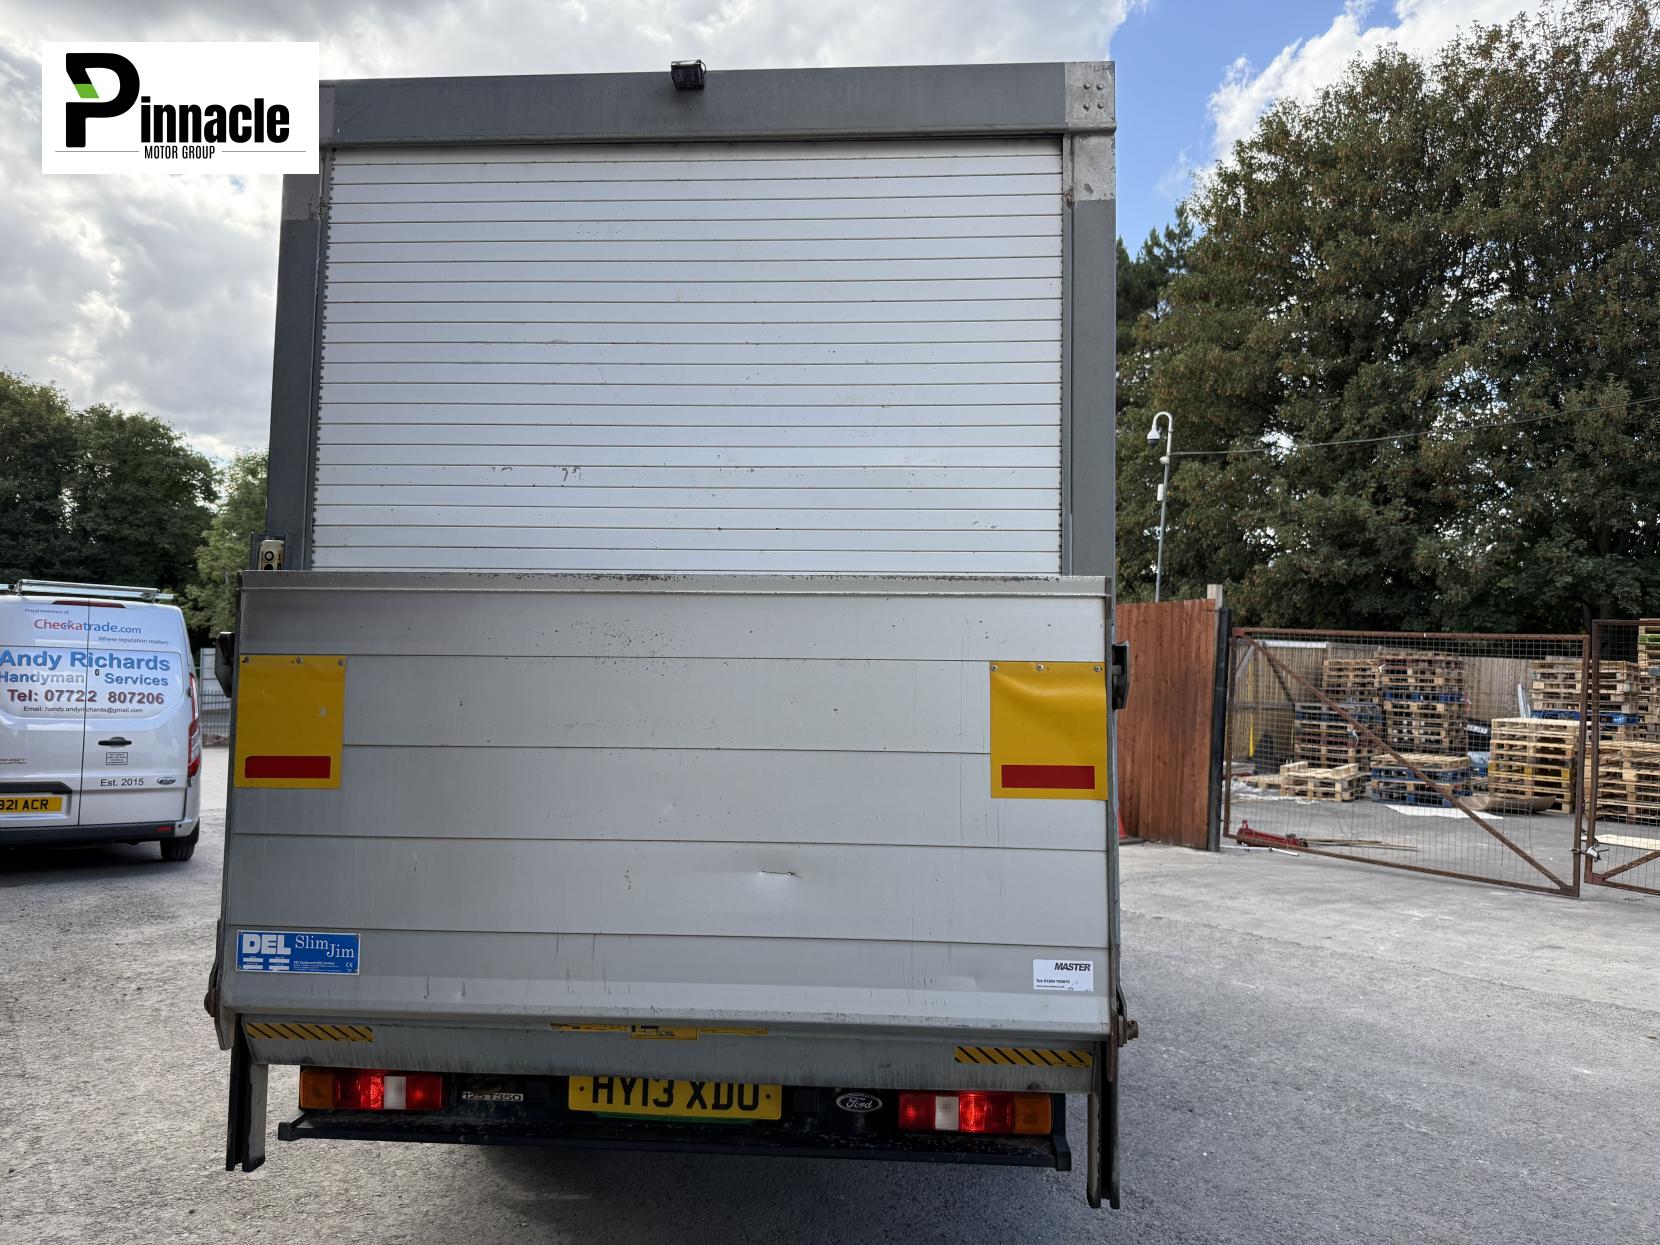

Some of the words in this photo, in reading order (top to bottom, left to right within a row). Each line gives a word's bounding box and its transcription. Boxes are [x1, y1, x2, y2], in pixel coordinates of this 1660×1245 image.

[34, 619, 142, 634] Checkatrade.com
[0, 649, 62, 671] Andy
[70, 650, 171, 672] Richards
[0, 671, 85, 685] Handyman
[104, 672, 169, 686] Services
[7, 688, 38, 702] Tel:
[44, 689, 97, 702] 07722
[107, 691, 165, 704] 807206
[100, 778, 118, 787] Est.
[121, 778, 144, 787] 2015
[22, 799, 49, 810] ACR
[242, 933, 292, 955] DEL
[295, 935, 328, 949] Slim
[326, 943, 355, 958] Jim
[1054, 963, 1091, 971] MASTER
[592, 1077, 675, 1108] HY13
[686, 1080, 760, 1112] XDU
[846, 1096, 873, 1109] Ford
